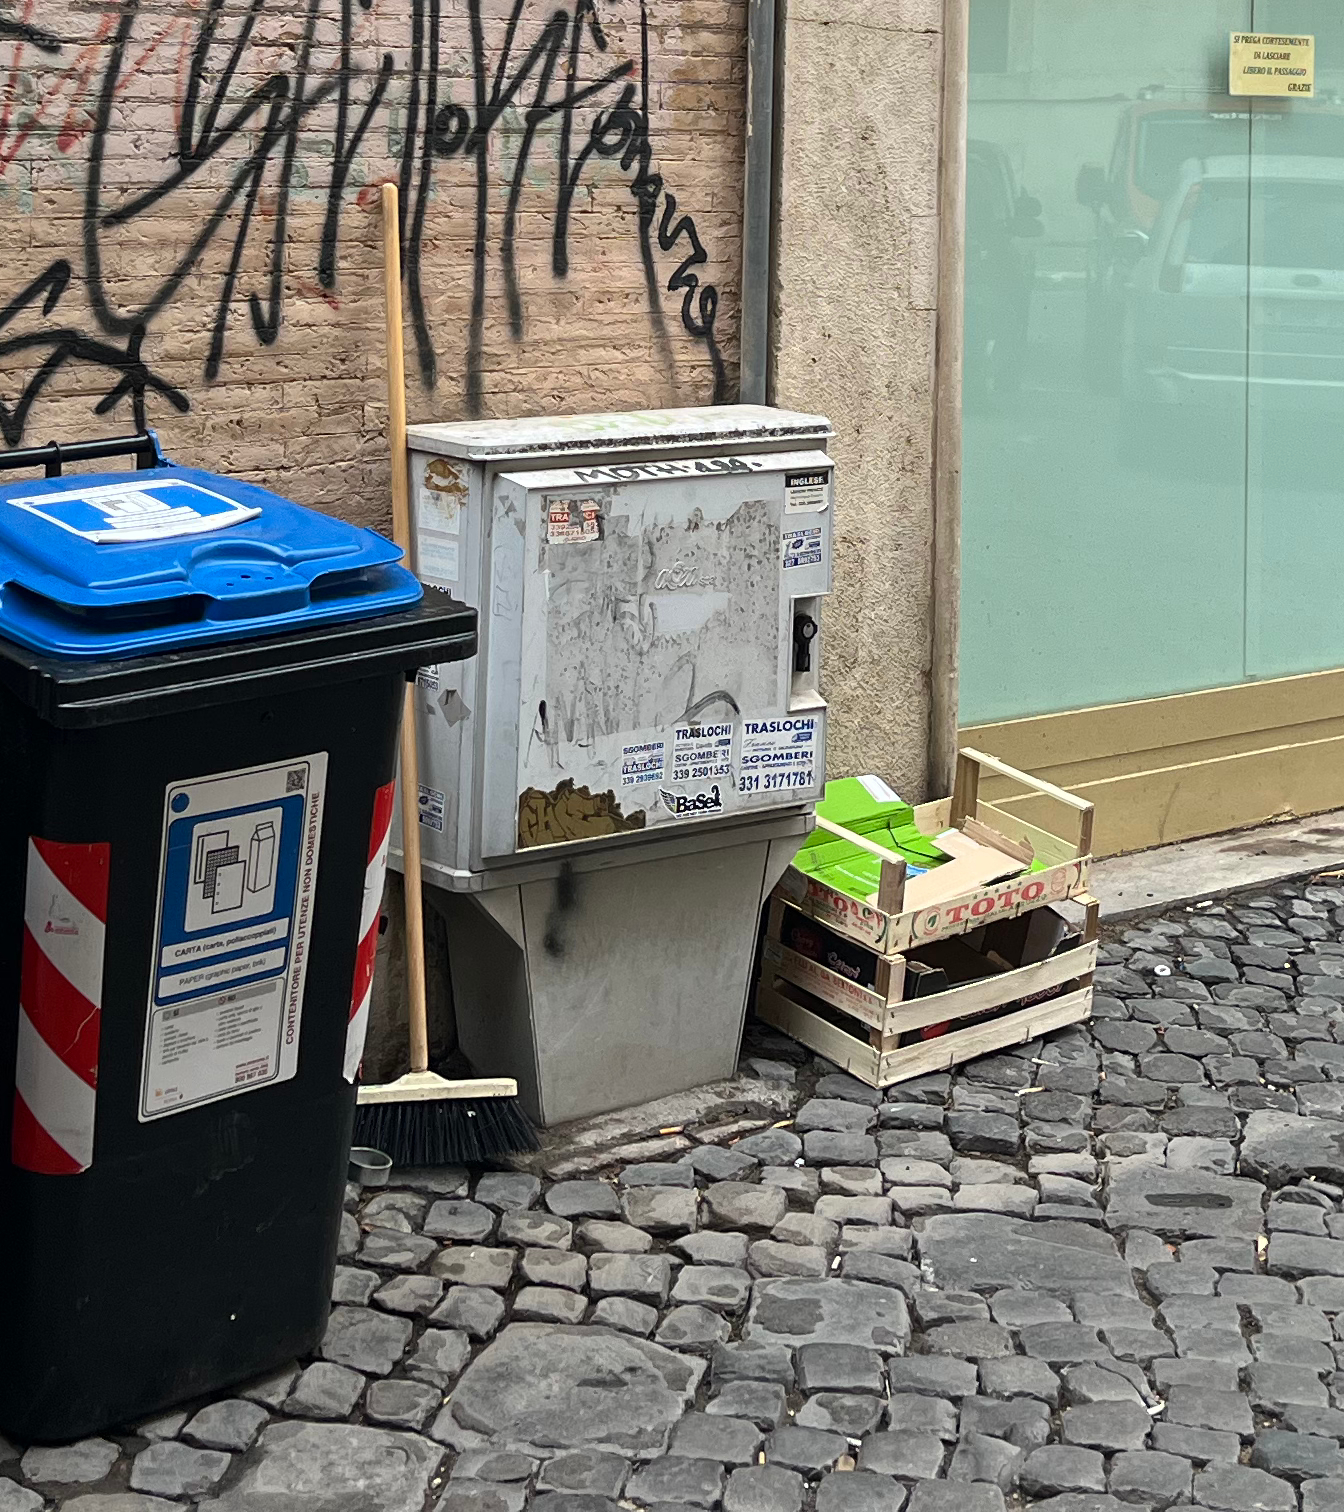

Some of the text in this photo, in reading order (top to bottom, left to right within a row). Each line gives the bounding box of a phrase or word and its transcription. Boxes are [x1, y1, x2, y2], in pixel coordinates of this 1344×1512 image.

[675, 724, 732, 740] TRASLOCHI
[744, 719, 814, 735] TRASLOCHI
[623, 742, 664, 754] SGOMBERI
[675, 749, 730, 763] SGOMBERI
[741, 751, 813, 764] SGOMBERI
[673, 769, 690, 780] 339
[739, 775, 759, 791] 331
[946, 881, 1045, 925] TOTO
[286, 792, 321, 1045] CONTENITORE PER UTENZE NON DOMESTICHE
[174, 945, 202, 958] CARTA
[179, 973, 205, 986] PAPER
